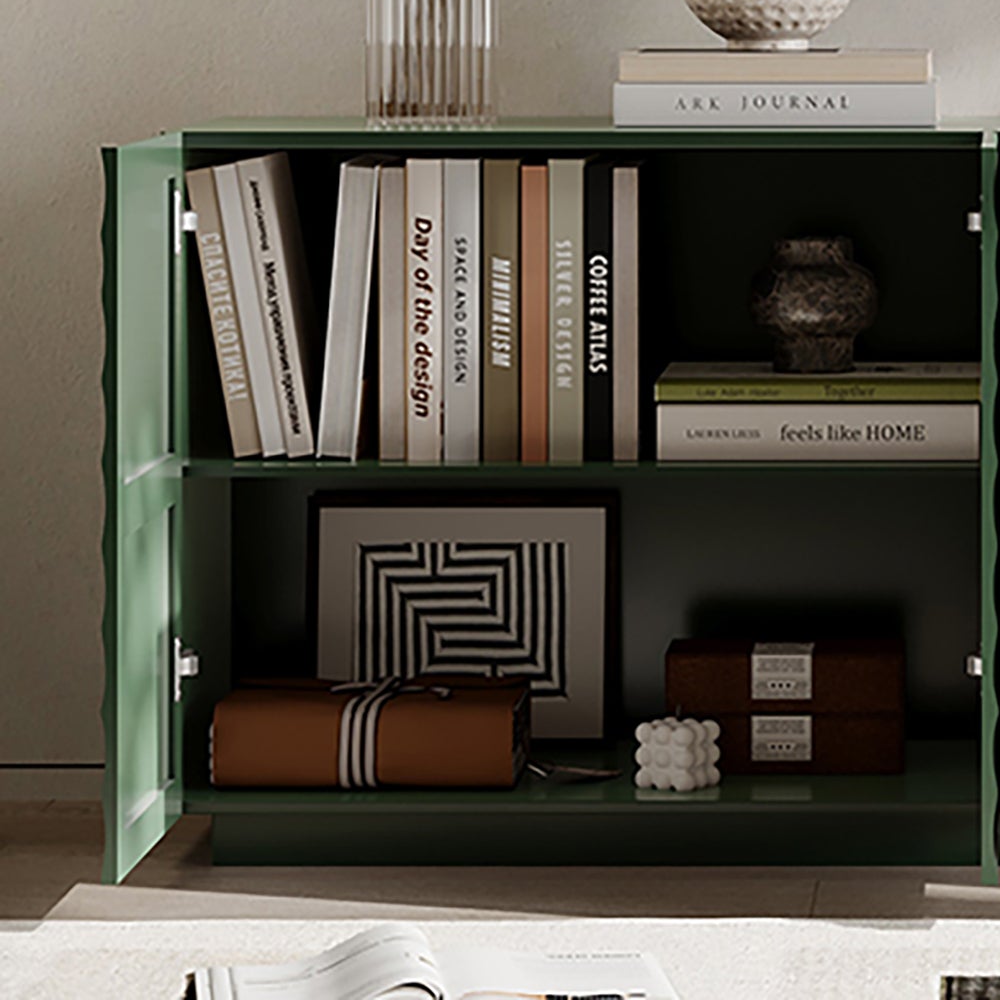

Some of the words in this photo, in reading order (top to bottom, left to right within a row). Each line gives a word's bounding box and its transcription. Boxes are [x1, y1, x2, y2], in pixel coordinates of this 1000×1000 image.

[674, 97, 720, 110] ARK
[740, 95, 850, 111] JOURNAL
[411, 217, 433, 261] Day
[453, 236, 468, 284] SPACE
[200, 231, 233, 317] СПАСИТЕ
[413, 267, 433, 293] of
[555, 239, 573, 307] SILVER
[588, 254, 608, 316] COFFEE
[414, 298, 433, 335] the
[453, 289, 467, 322] AND
[491, 256, 511, 368] MINIMALISM
[214, 317, 248, 401] КОТИКА!
[453, 327, 467, 384] DESIGN
[555, 317, 573, 389] DESIGN
[588, 320, 608, 374] ATLAS
[411, 341, 433, 418] design
[780, 424, 824, 442] feels
[827, 424, 862, 442] like
[866, 424, 926, 442] HOME
